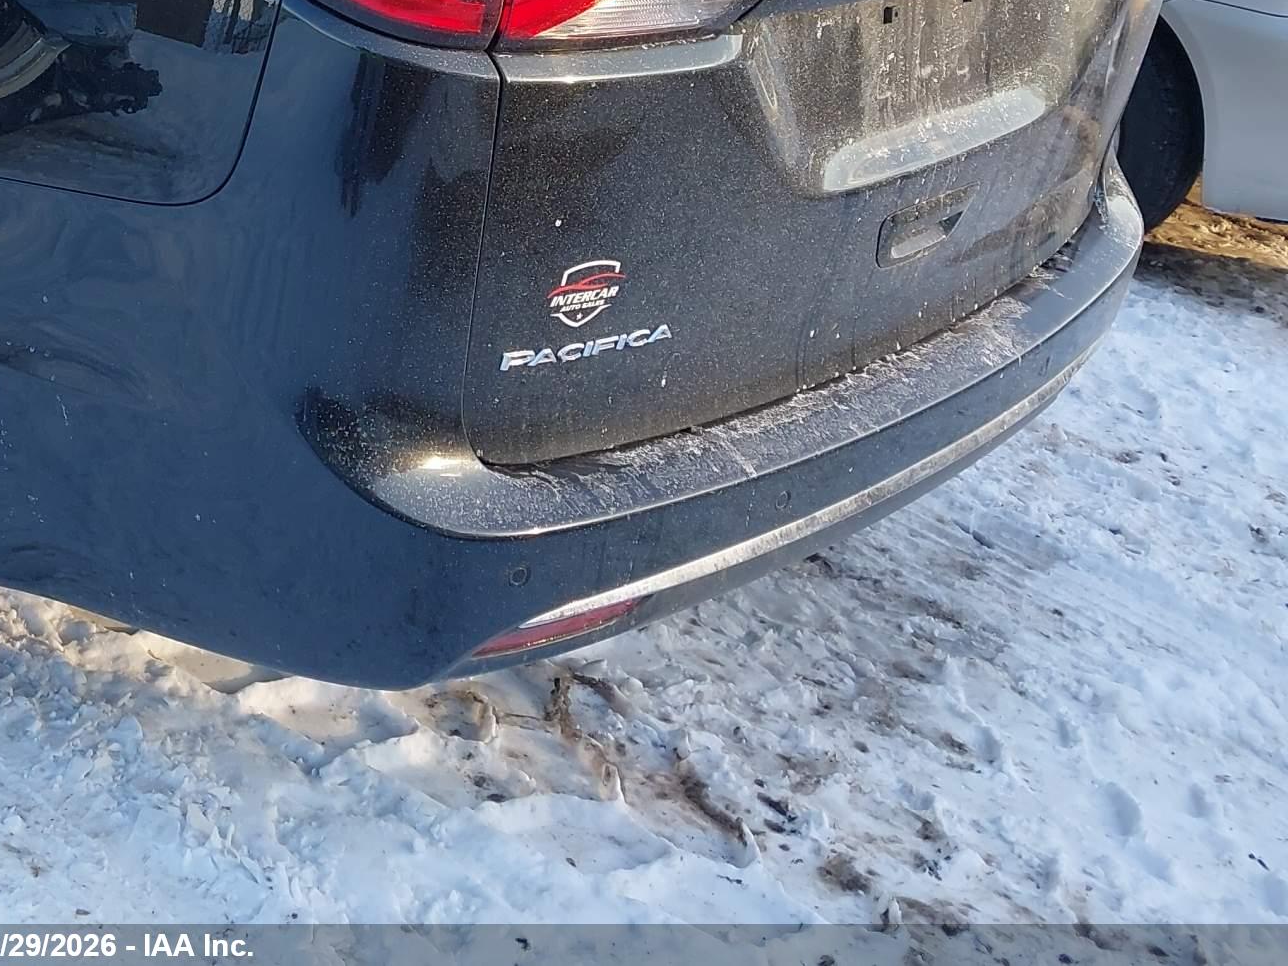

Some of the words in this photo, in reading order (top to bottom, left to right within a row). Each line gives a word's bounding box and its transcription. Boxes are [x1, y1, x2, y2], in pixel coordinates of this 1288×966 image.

[549, 285, 619, 307] INTERCAR
[559, 303, 581, 313] AUTO
[582, 299, 605, 309] SALES
[499, 324, 672, 371] PACIFICA
